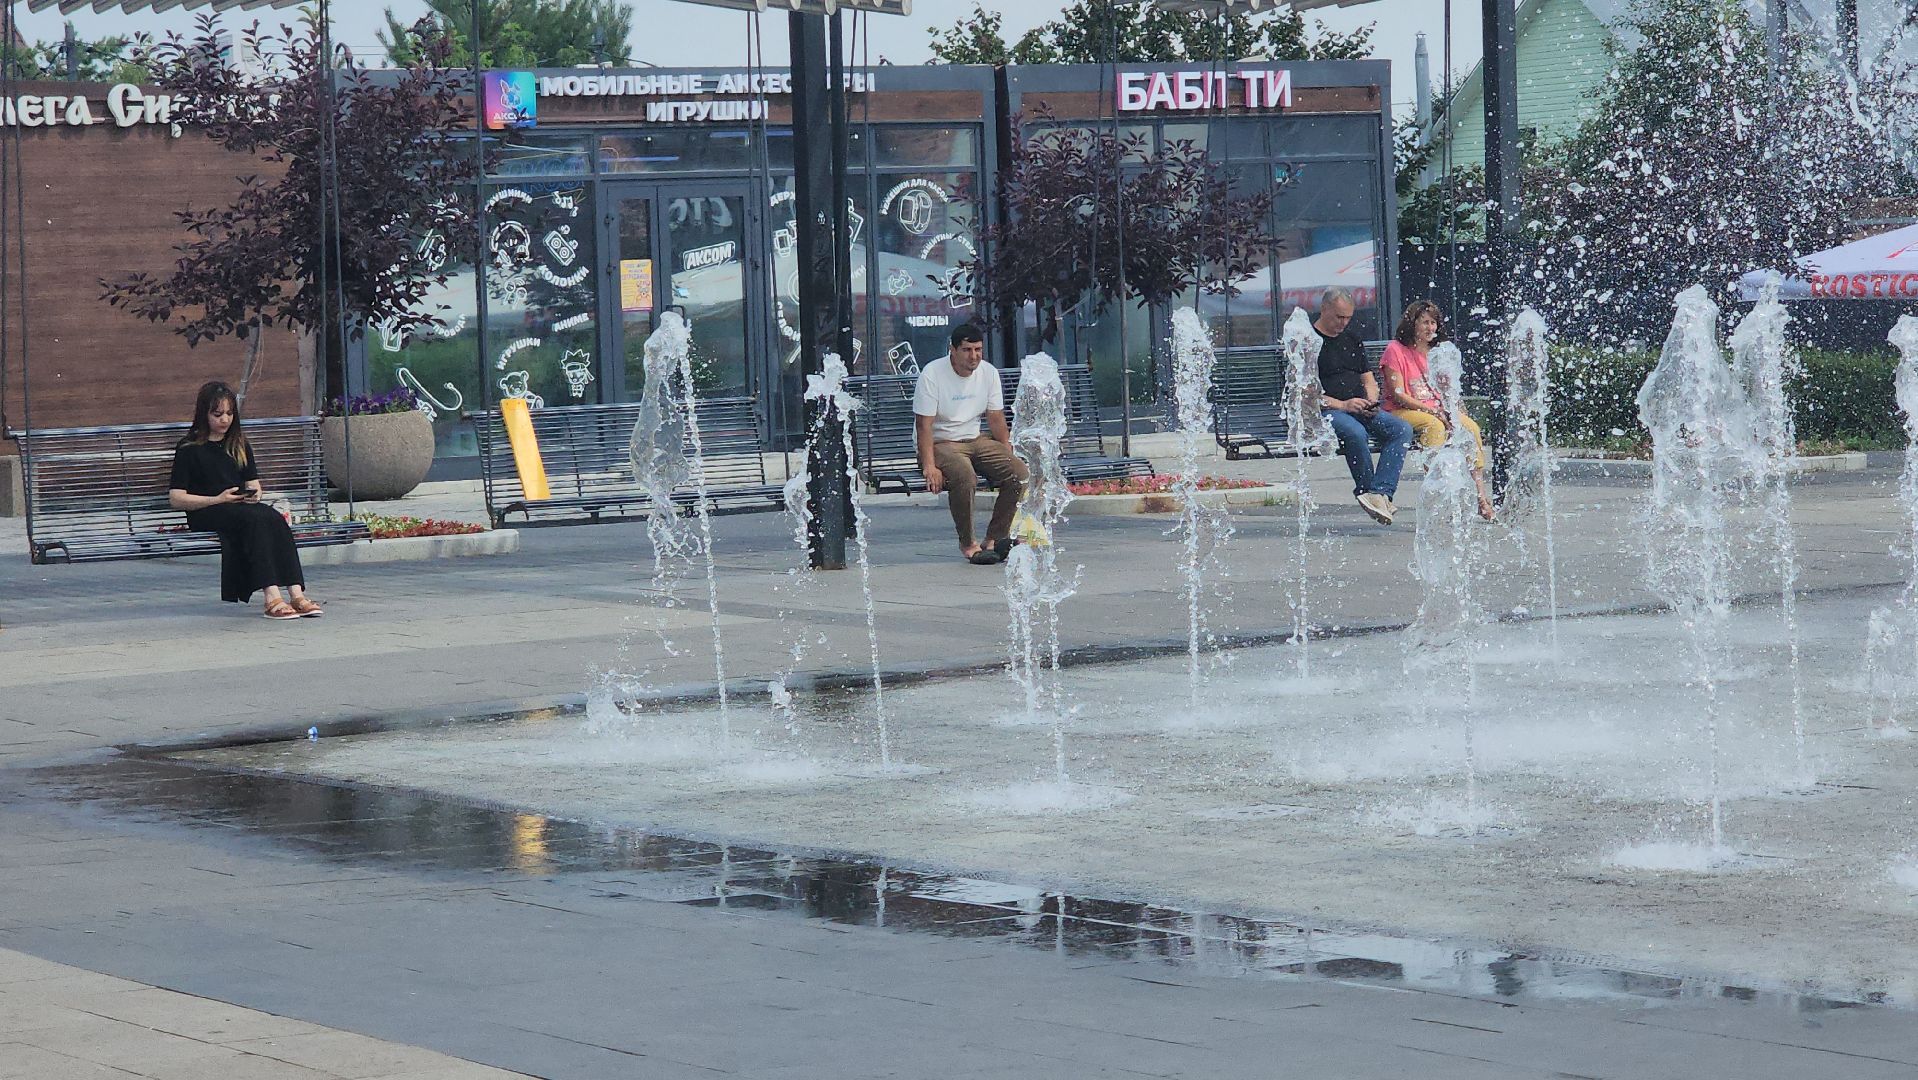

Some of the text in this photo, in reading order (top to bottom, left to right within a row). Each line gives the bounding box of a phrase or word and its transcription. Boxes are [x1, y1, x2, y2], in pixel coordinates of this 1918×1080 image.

[540, 73, 875, 97] МОБИЛЬНЫЕ АКСЕСРЫ
[1117, 69, 1292, 110] БАБЛ ТИ
[646, 100, 769, 122] ИГРУШКИ
[910, 178, 928, 188] ДЛЯ
[538, 264, 590, 288] КОЛОНКИ
[433, 313, 466, 337] ПРОВОДА
[553, 312, 590, 333] АНИМЕ
[907, 315, 949, 327] ЧЕХЛЫ
[498, 338, 541, 370] ИГРУШКИ
